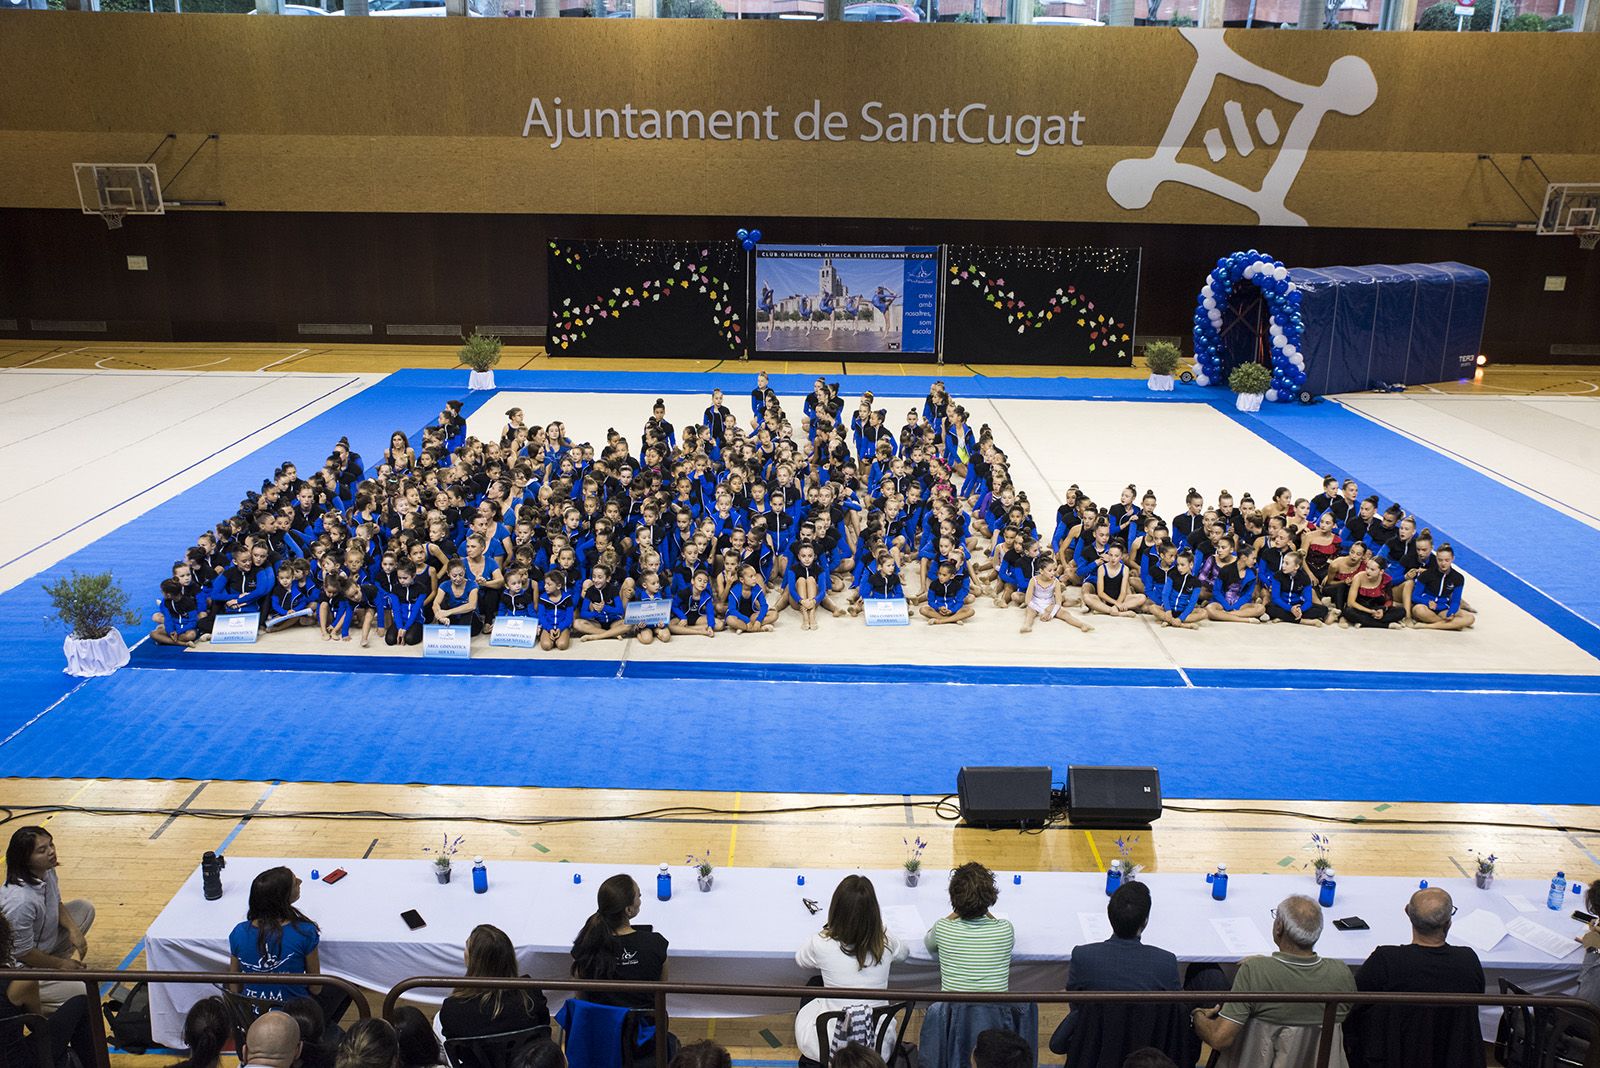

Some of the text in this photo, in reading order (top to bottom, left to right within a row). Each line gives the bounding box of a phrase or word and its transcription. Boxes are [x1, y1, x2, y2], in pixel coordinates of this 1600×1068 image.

[522, 97, 1086, 156] Ajuntament de SantCugat
